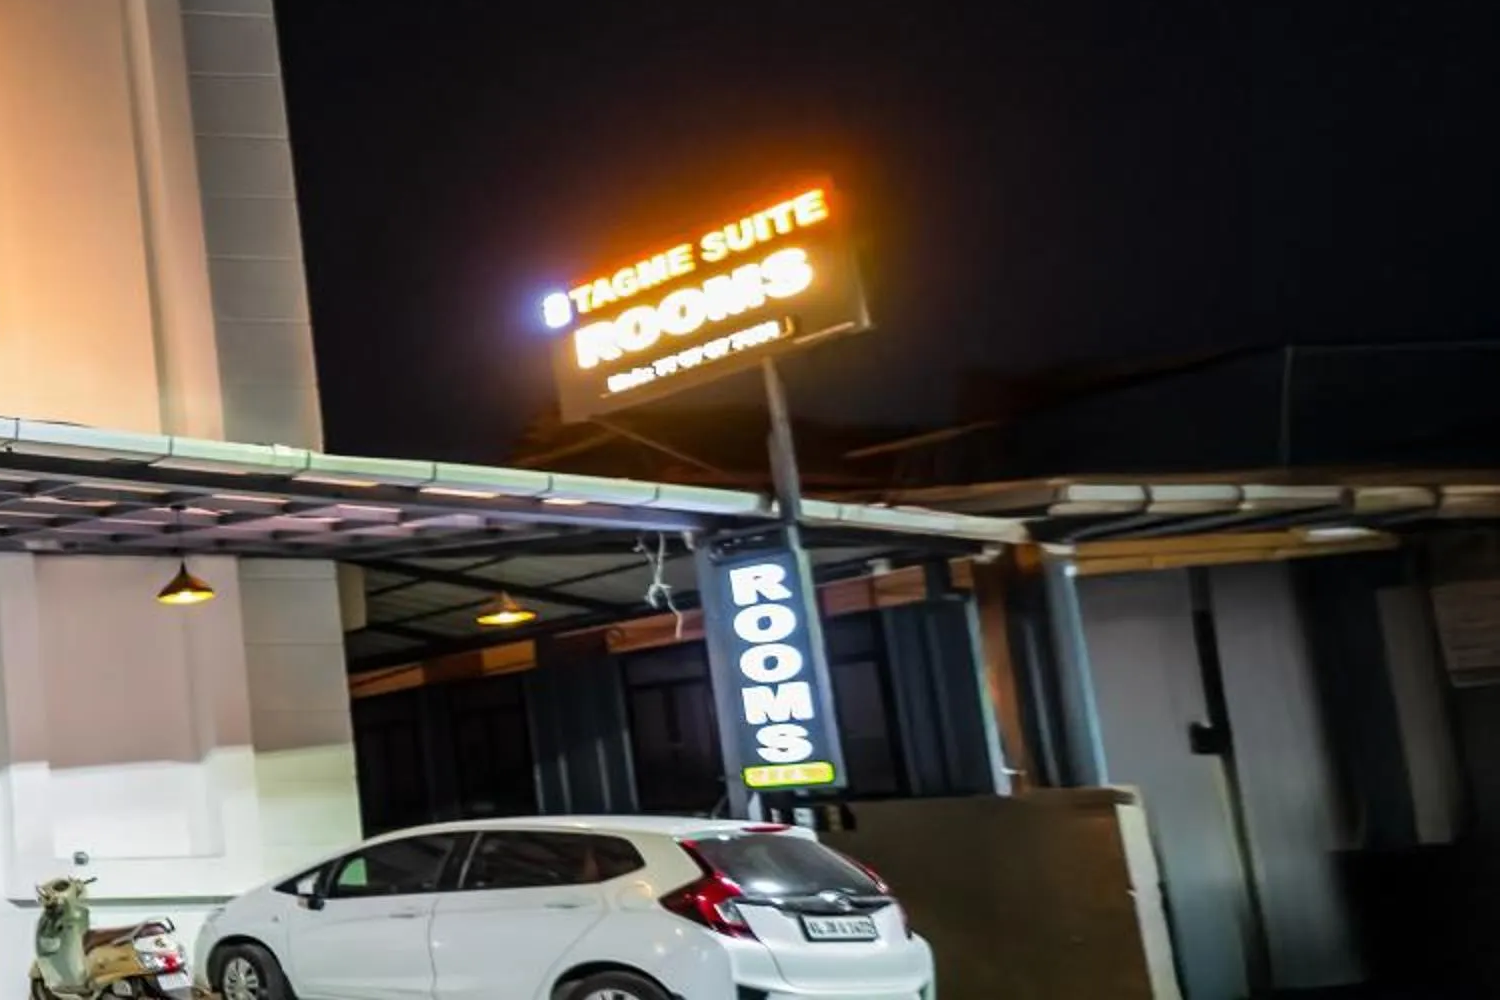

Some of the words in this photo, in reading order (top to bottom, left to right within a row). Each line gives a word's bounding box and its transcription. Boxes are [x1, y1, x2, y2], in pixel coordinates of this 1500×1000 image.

[569, 243, 695, 313] TAGME
[700, 189, 828, 262] SUITE
[573, 247, 813, 370] ROOMS
[729, 563, 815, 763] ROOMS
